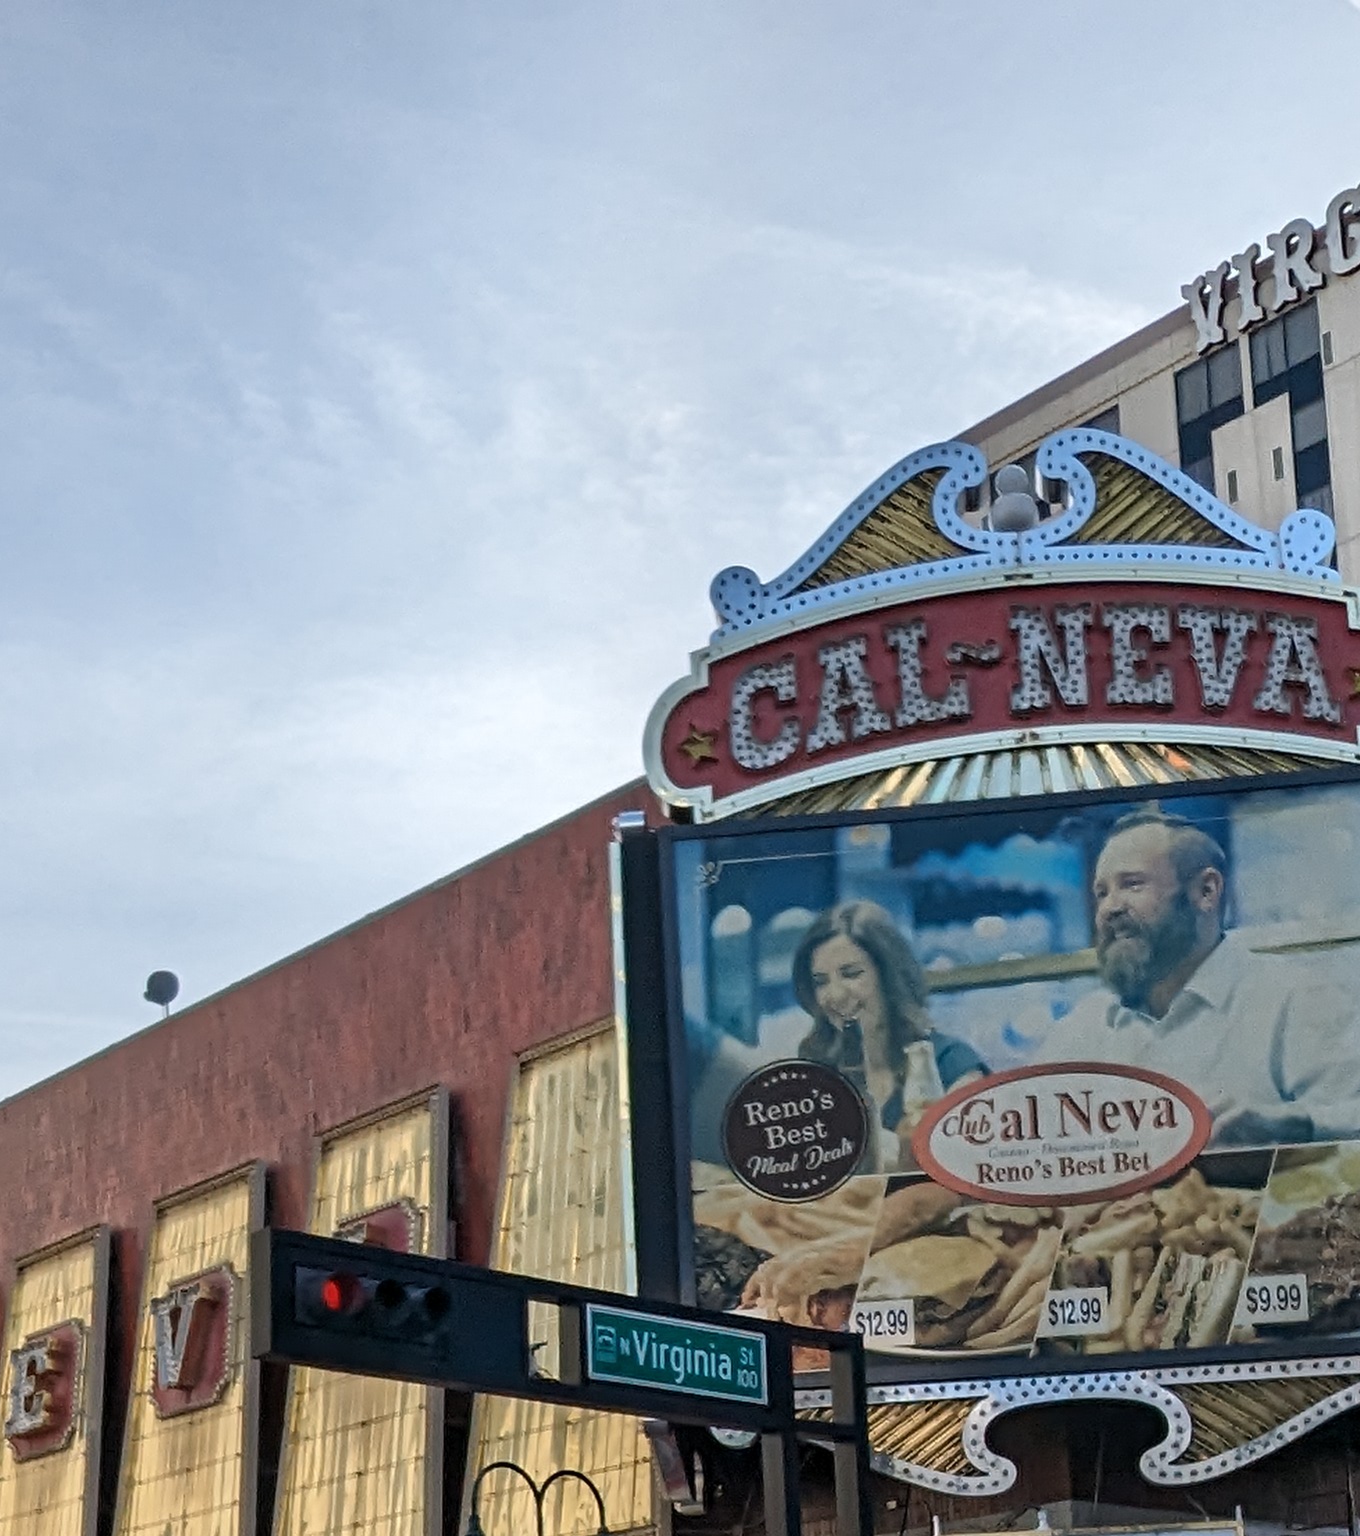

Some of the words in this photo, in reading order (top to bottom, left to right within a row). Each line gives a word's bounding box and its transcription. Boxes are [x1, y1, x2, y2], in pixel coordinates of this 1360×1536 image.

[743, 1088, 835, 1126] Reno's
[960, 1095, 1043, 1146] Cal
[1054, 1090, 1179, 1138] Neva
[764, 1118, 828, 1150] Best
[942, 1113, 992, 1138] Club
[746, 1153, 799, 1178] Meal
[976, 1158, 1053, 1184] Reno's
[1058, 1155, 1107, 1178] Best
[1113, 1151, 1150, 1173] Bet
[1048, 1297, 1103, 1326] $12.99
[1245, 1283, 1301, 1313] $9.99
[855, 1310, 909, 1337] $12.99
[619, 1336, 631, 1357] N
[632, 1329, 732, 1385] Virginia
[740, 1346, 755, 1367] St
[737, 1368, 759, 1390] 100
